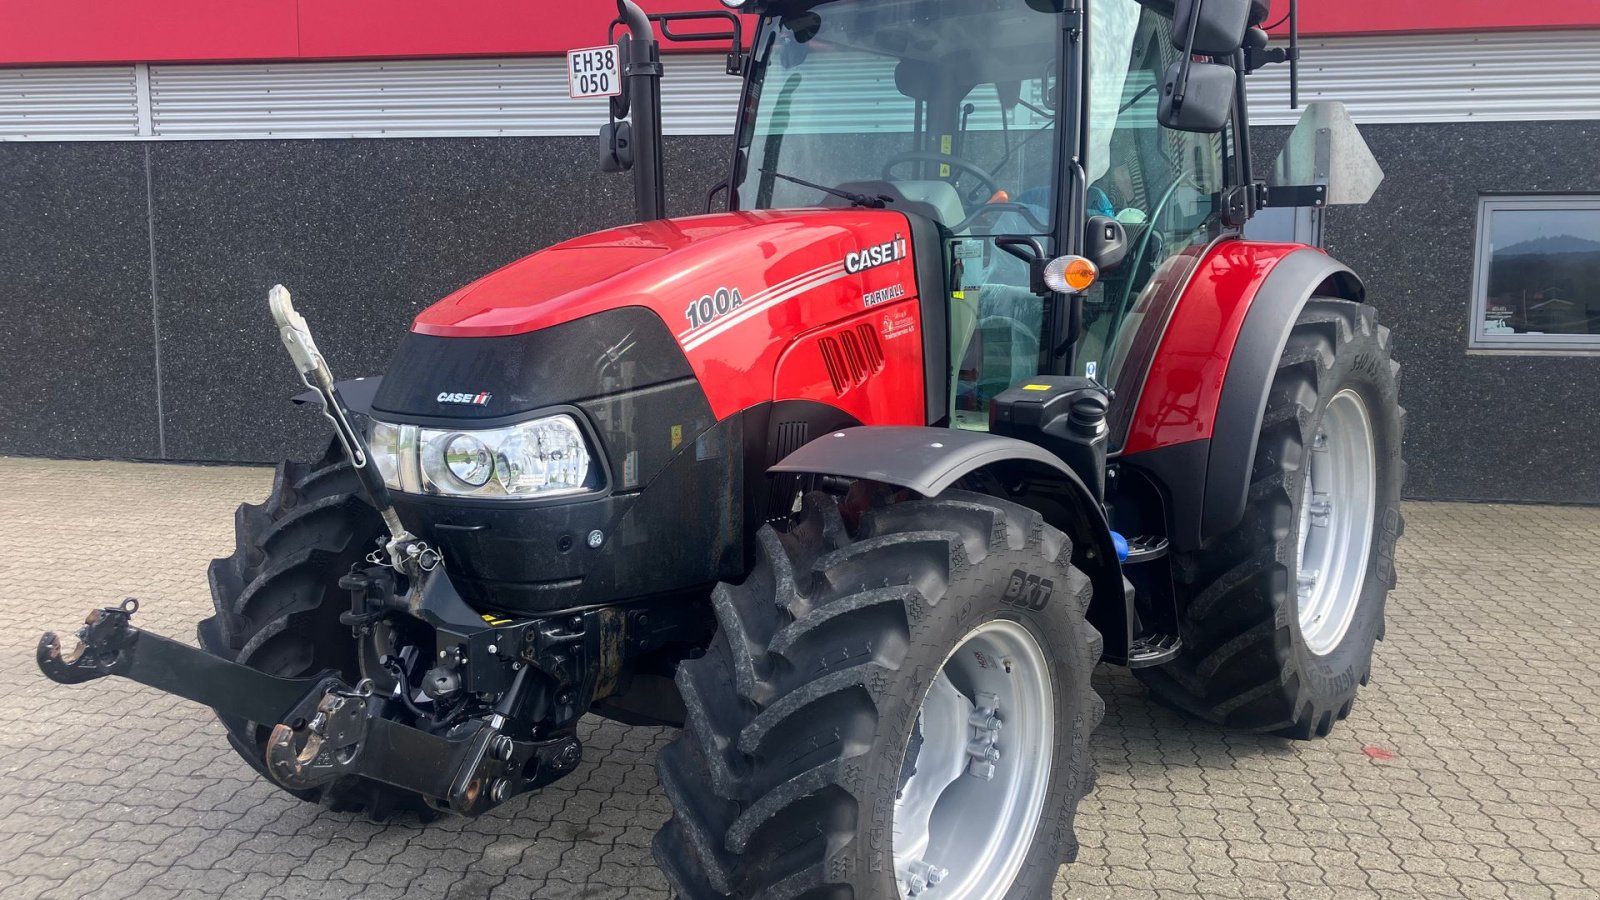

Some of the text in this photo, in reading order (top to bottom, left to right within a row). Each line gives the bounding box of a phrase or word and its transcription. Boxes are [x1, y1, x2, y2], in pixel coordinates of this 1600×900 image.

[572, 50, 614, 73] EH38
[580, 73, 609, 94] 050
[863, 283, 905, 307] FARMALL
[685, 286, 744, 331] 100A
[436, 392, 474, 403] CASE
[1001, 569, 1054, 612] BKT
